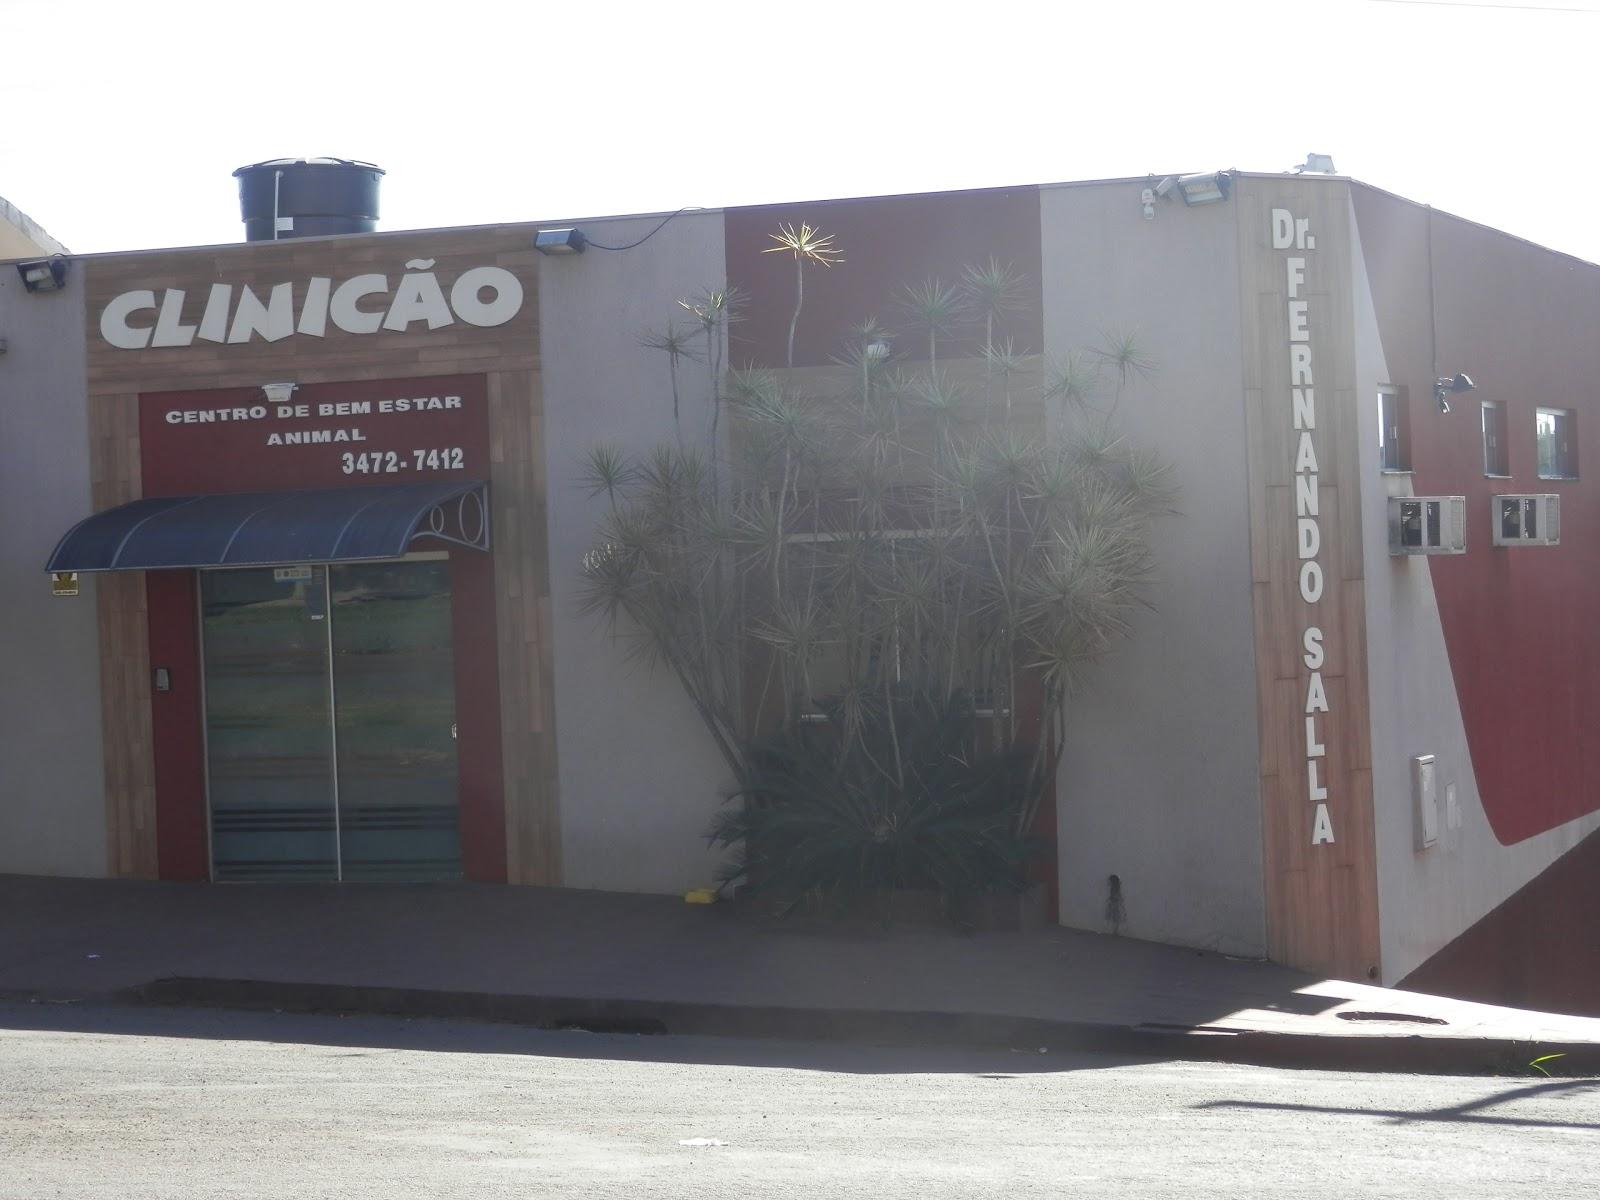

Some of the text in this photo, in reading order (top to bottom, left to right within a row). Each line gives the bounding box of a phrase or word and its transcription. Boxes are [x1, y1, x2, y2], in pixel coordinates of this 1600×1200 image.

[100, 258, 524, 349] CLINICÃO
[165, 396, 462, 424] CENTRO DE BEM ESTAR
[266, 428, 366, 446] ANIMAL
[1272, 208, 1335, 845] Dr. FERNANDO SALLA
